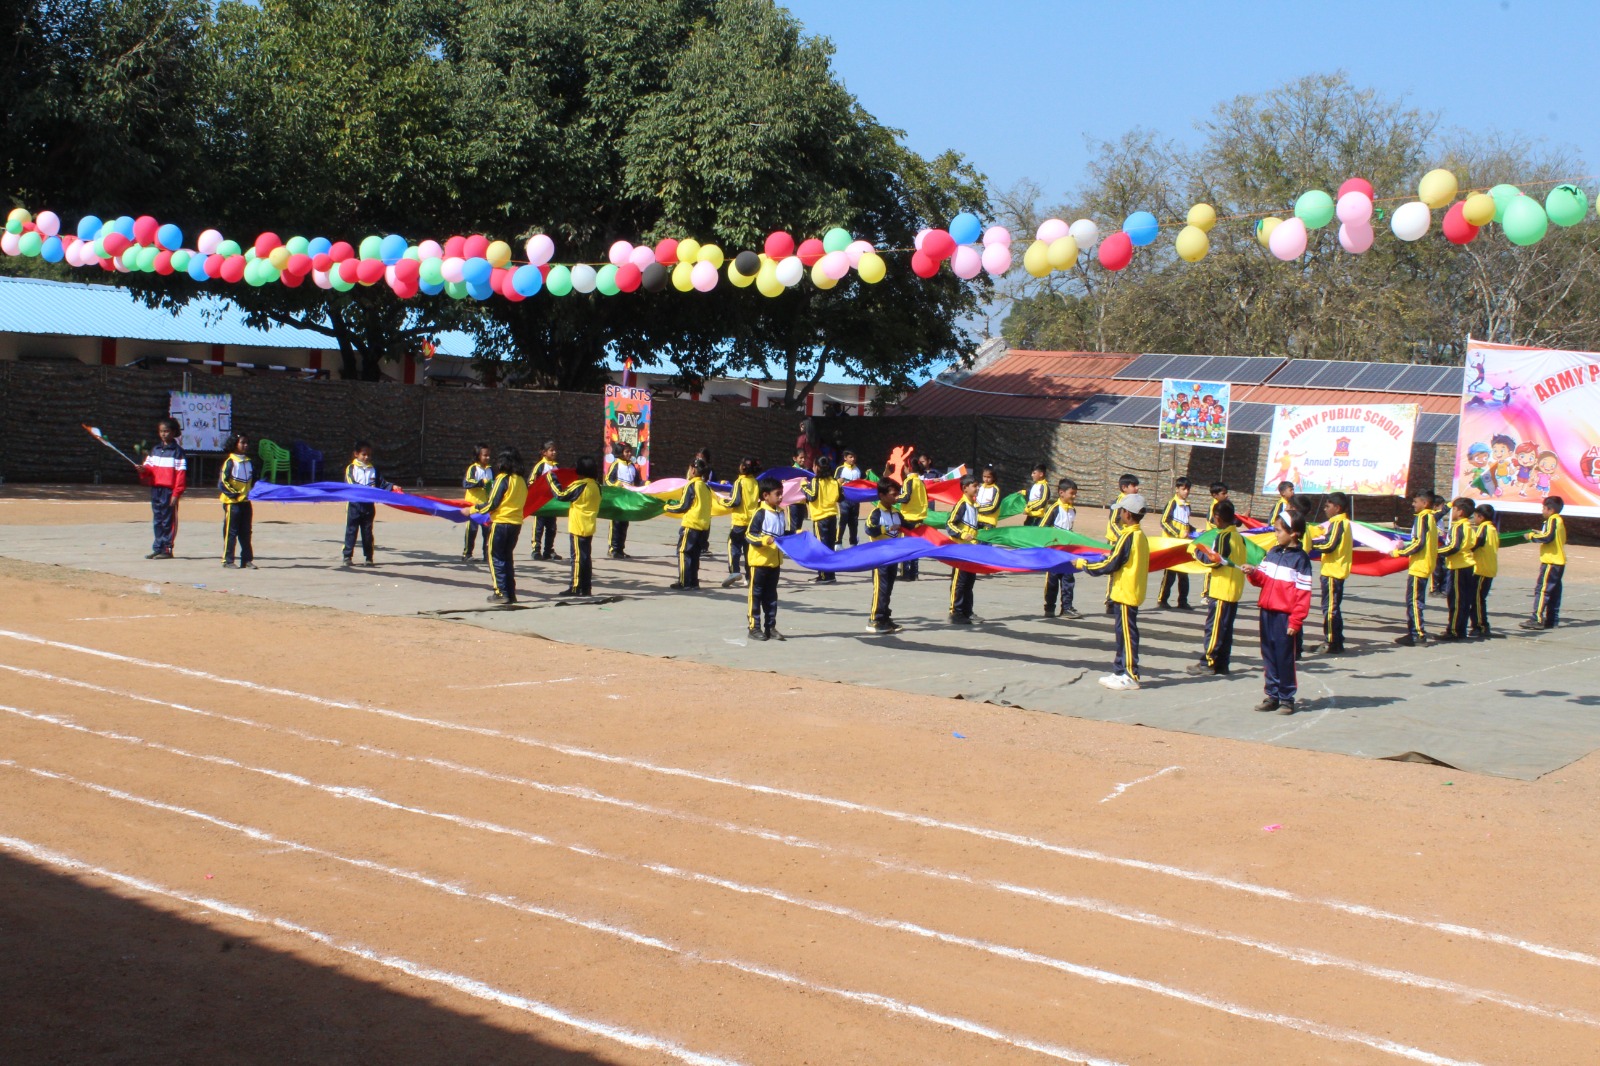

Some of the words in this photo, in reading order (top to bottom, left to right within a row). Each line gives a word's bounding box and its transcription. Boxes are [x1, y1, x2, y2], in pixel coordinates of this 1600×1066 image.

[1534, 366, 1583, 403] ARMY
[617, 413, 639, 427] DAY
[1288, 414, 1318, 439] ARMY
[1322, 408, 1362, 422] PUBLIC
[1363, 410, 1404, 440] SCHOOL
[1304, 458, 1332, 466] Annual
[1334, 458, 1360, 468] Sports
[1362, 459, 1378, 468] Day
